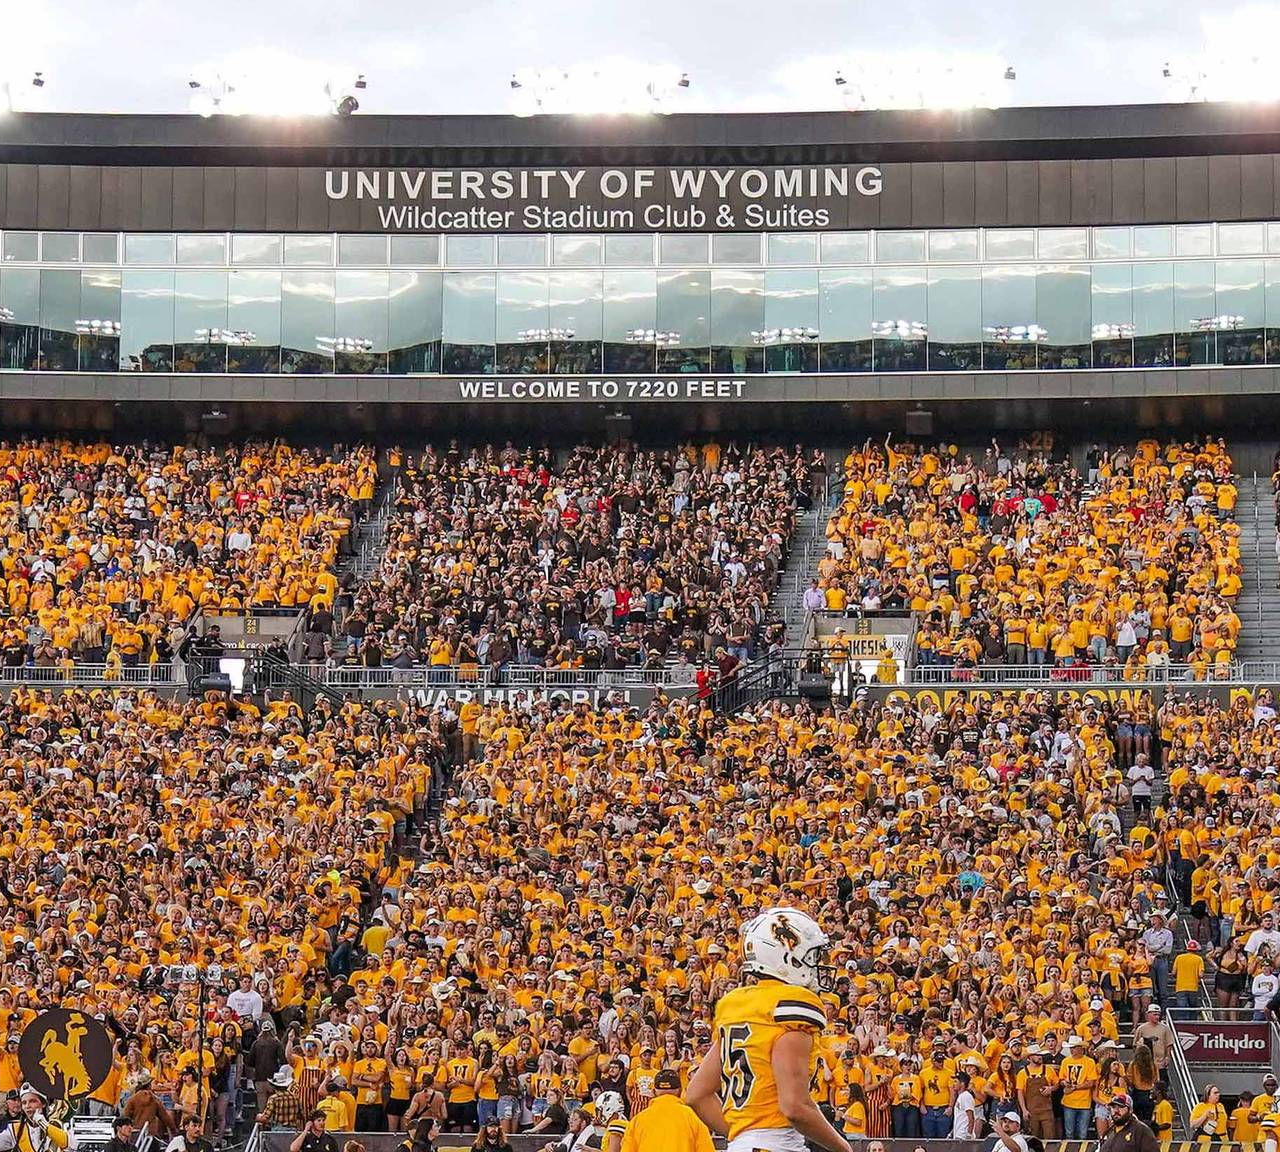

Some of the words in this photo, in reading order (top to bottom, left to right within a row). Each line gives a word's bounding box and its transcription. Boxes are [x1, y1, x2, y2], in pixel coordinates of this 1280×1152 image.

[325, 169, 585, 200] UNIVERSITY
[600, 168, 655, 199] OF
[671, 167, 884, 198] WYOMING
[378, 205, 516, 229] Wildcatter
[522, 205, 634, 229] Stadium
[644, 204, 709, 228] Club
[717, 206, 736, 227] &
[744, 204, 829, 227] Suites
[459, 381, 579, 399] WELCOME
[588, 381, 619, 399] TO
[626, 380, 680, 398] 7220
[686, 380, 747, 398] FEET
[408, 689, 472, 710] WAR
[1200, 1033, 1266, 1055] Trihydro
